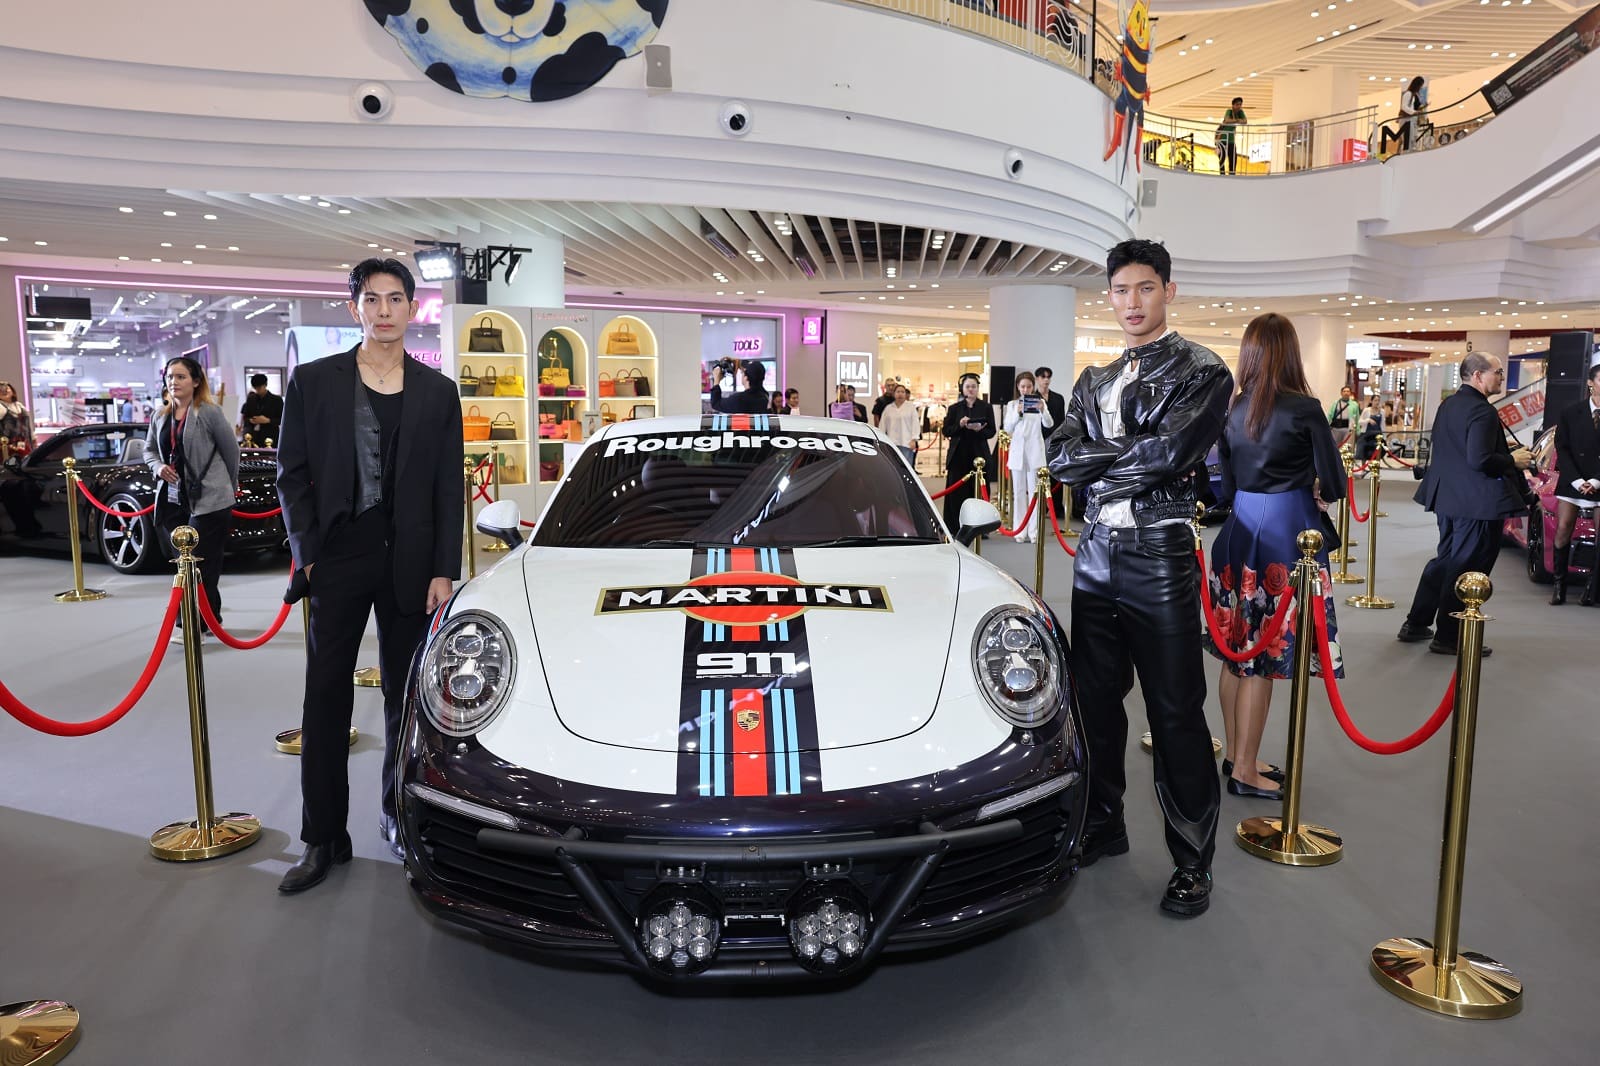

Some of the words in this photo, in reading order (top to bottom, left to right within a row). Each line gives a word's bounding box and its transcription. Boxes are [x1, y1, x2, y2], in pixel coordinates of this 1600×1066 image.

[733, 339, 760, 352] TOOLS
[1465, 341, 1473, 353] G
[840, 361, 868, 380] HLA
[603, 431, 879, 458] Roughroads
[618, 587, 873, 607] MARTINI
[696, 652, 795, 675] 911
